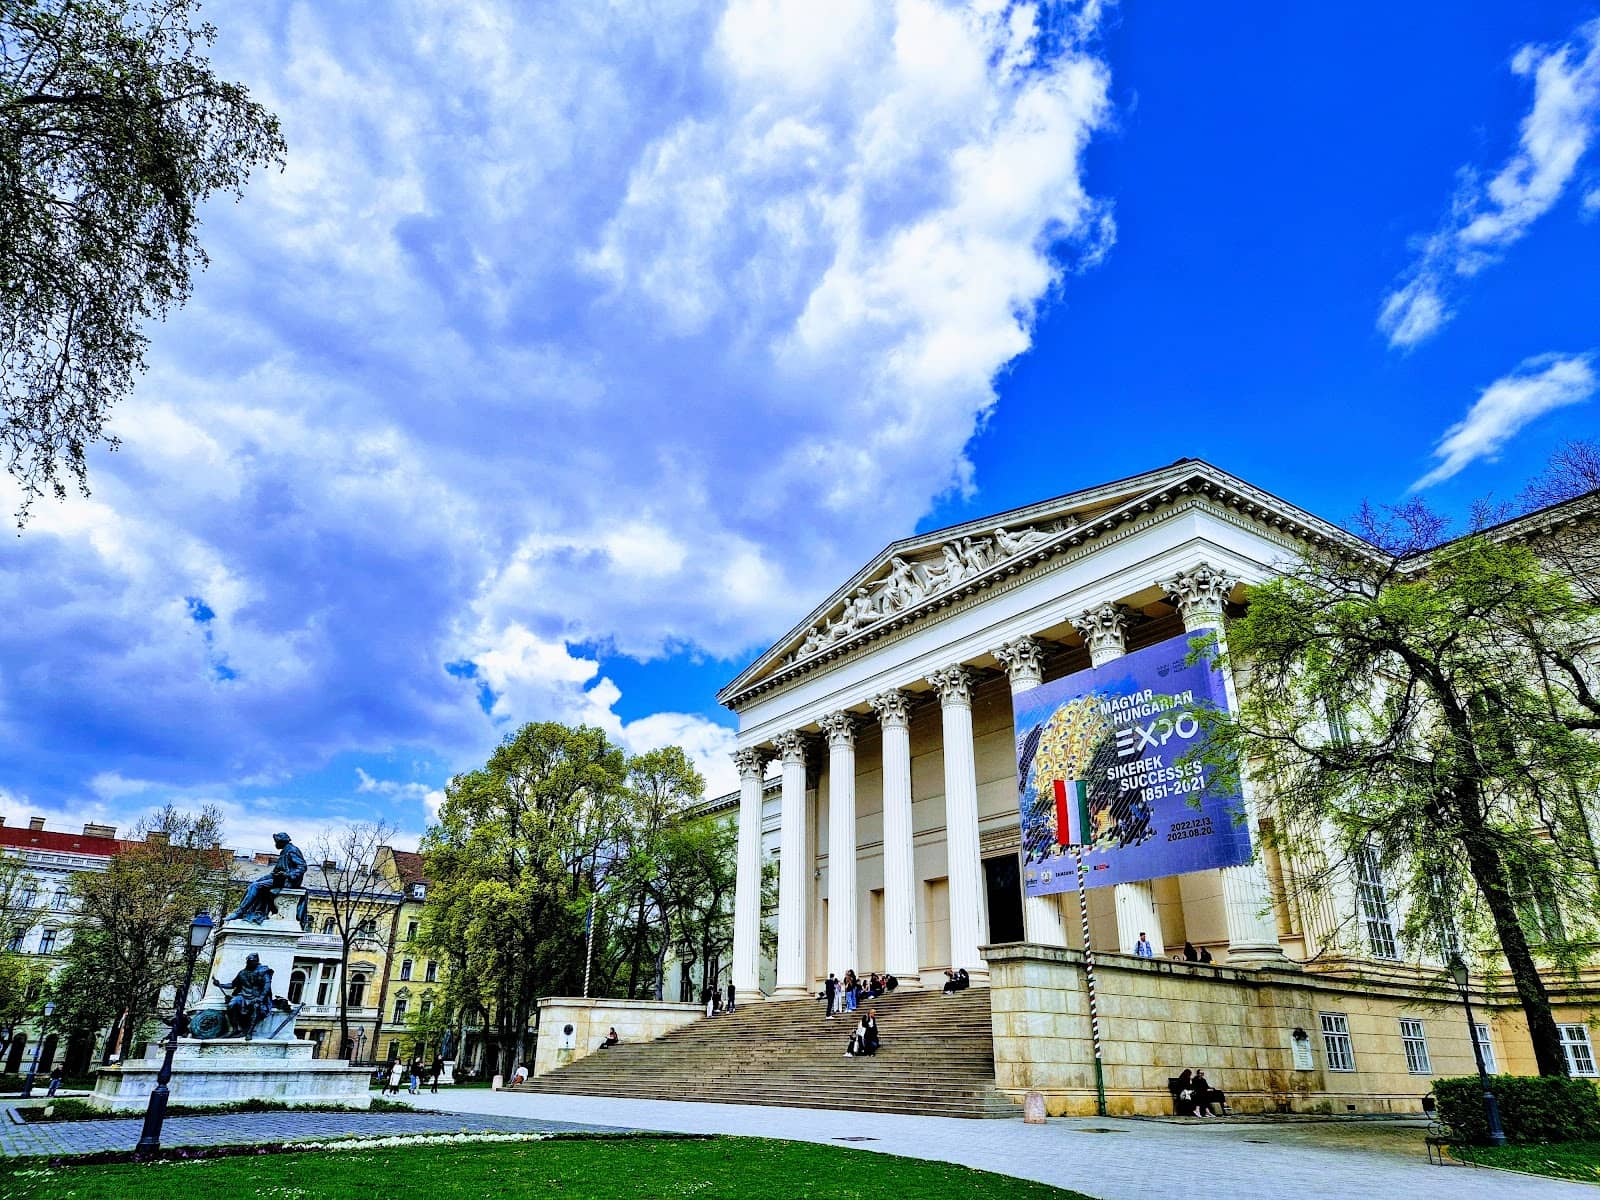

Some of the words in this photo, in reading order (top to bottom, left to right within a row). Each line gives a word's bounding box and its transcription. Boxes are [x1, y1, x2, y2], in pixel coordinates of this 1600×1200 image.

[1101, 689, 1153, 715] MAGYAR
[1113, 690, 1193, 725] HUNGARIAN
[1116, 712, 1199, 757] EXPO
[1107, 755, 1163, 780] SIKEREK
[1121, 760, 1203, 791] SUCCESSES
[1141, 776, 1205, 802] 1851-2021
[1168, 827, 1215, 841] 2023.08.20.
[1171, 817, 1213, 832] 2022.12.13.
